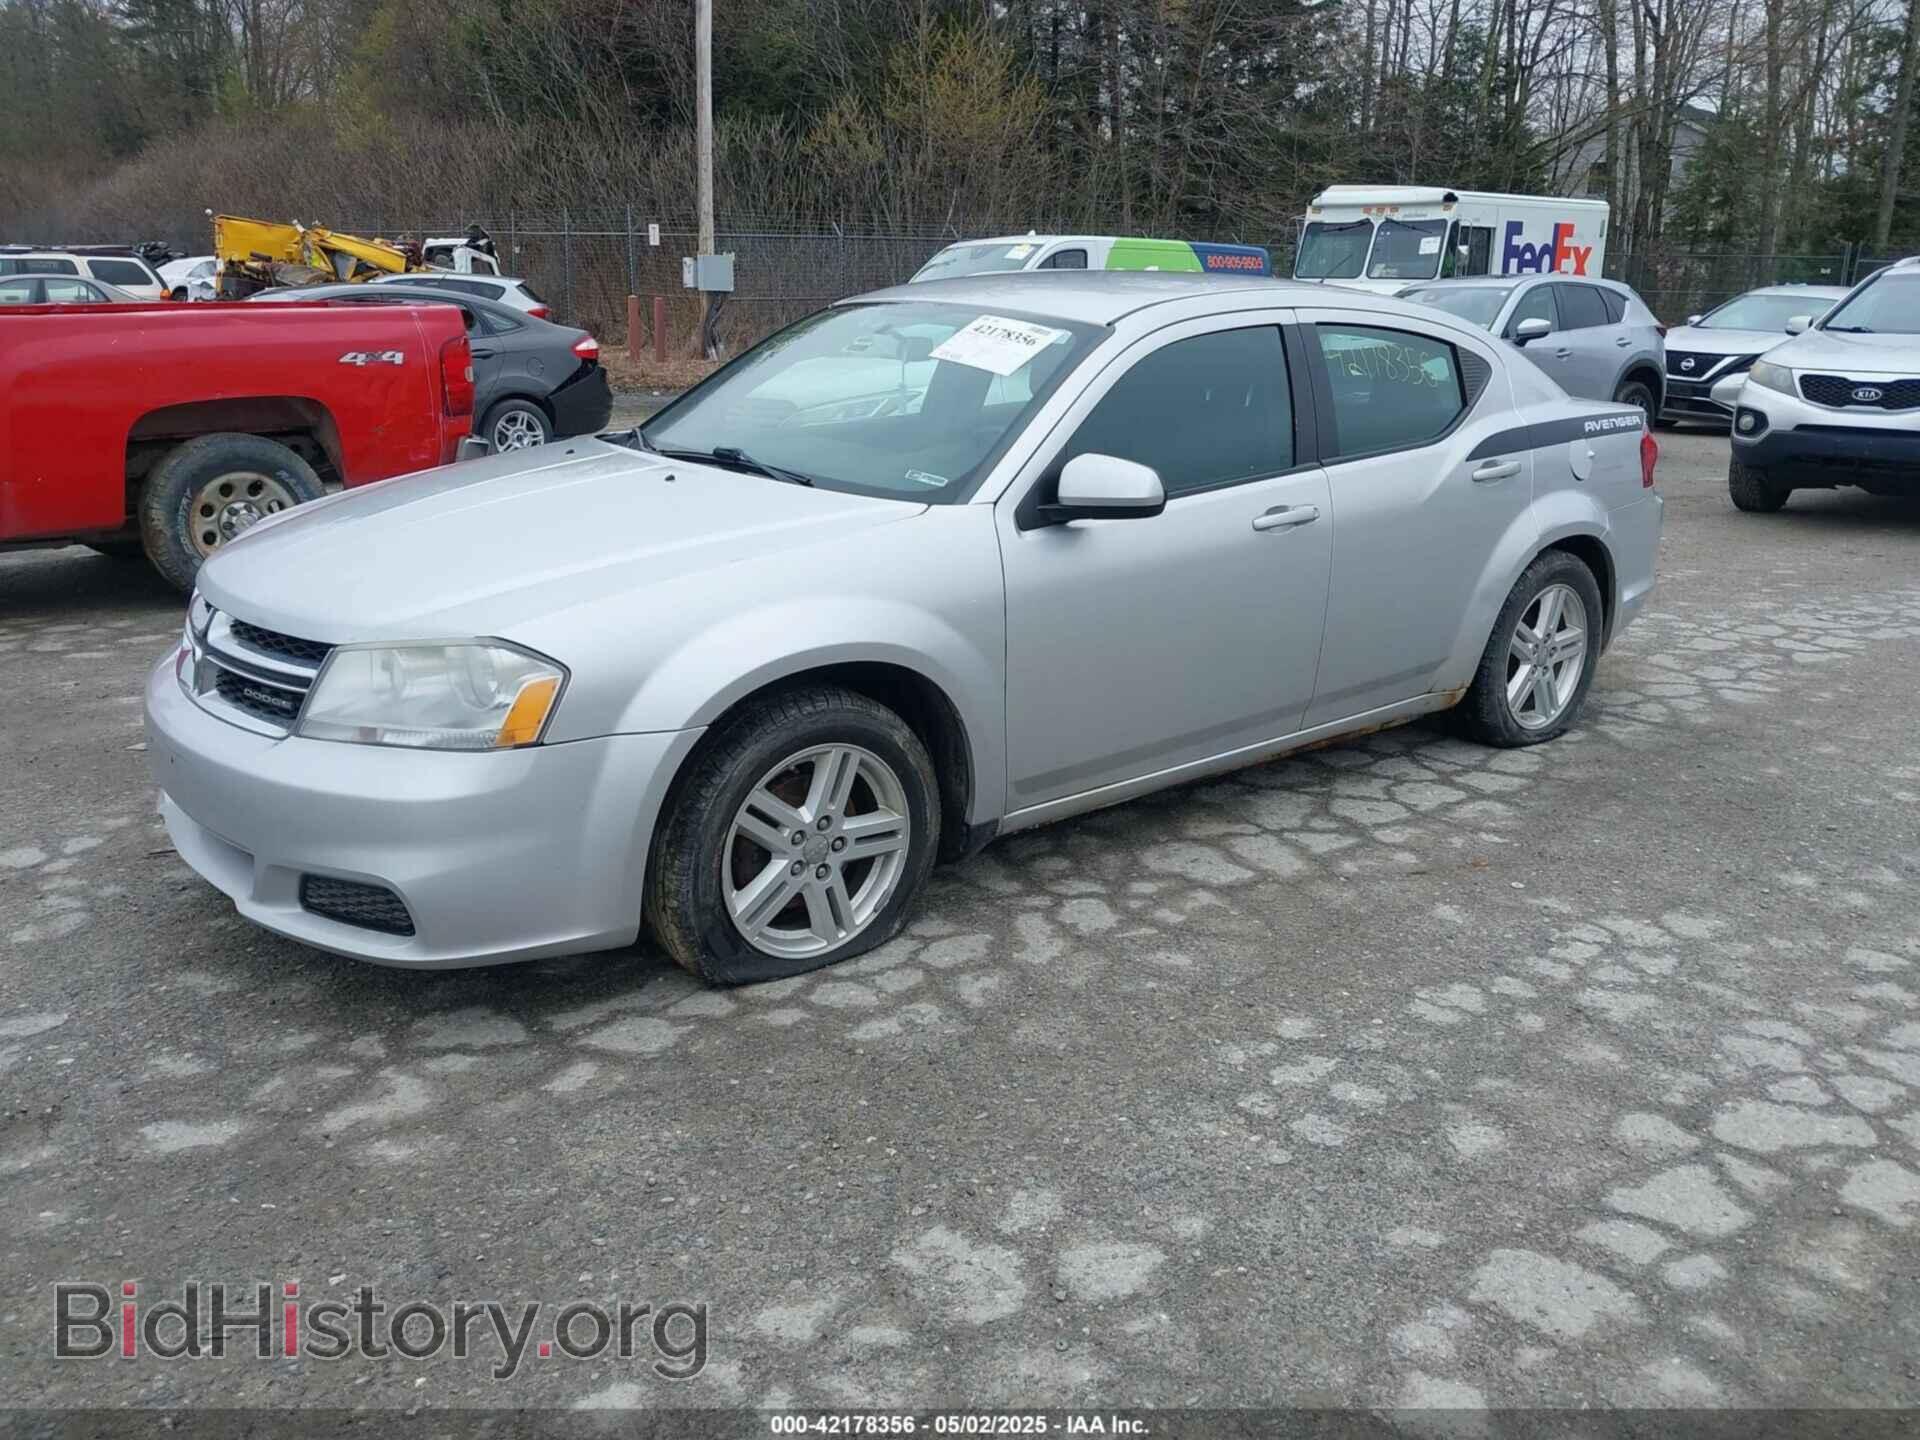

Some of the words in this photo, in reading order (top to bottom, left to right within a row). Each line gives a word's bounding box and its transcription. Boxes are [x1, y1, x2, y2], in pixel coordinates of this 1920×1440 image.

[1502, 220, 1592, 276] FedEx
[973, 324, 1038, 346] 42178356
[1857, 389, 1878, 398] KIA
[1584, 415, 1641, 432] AVENGER
[243, 687, 292, 708] DODGE
